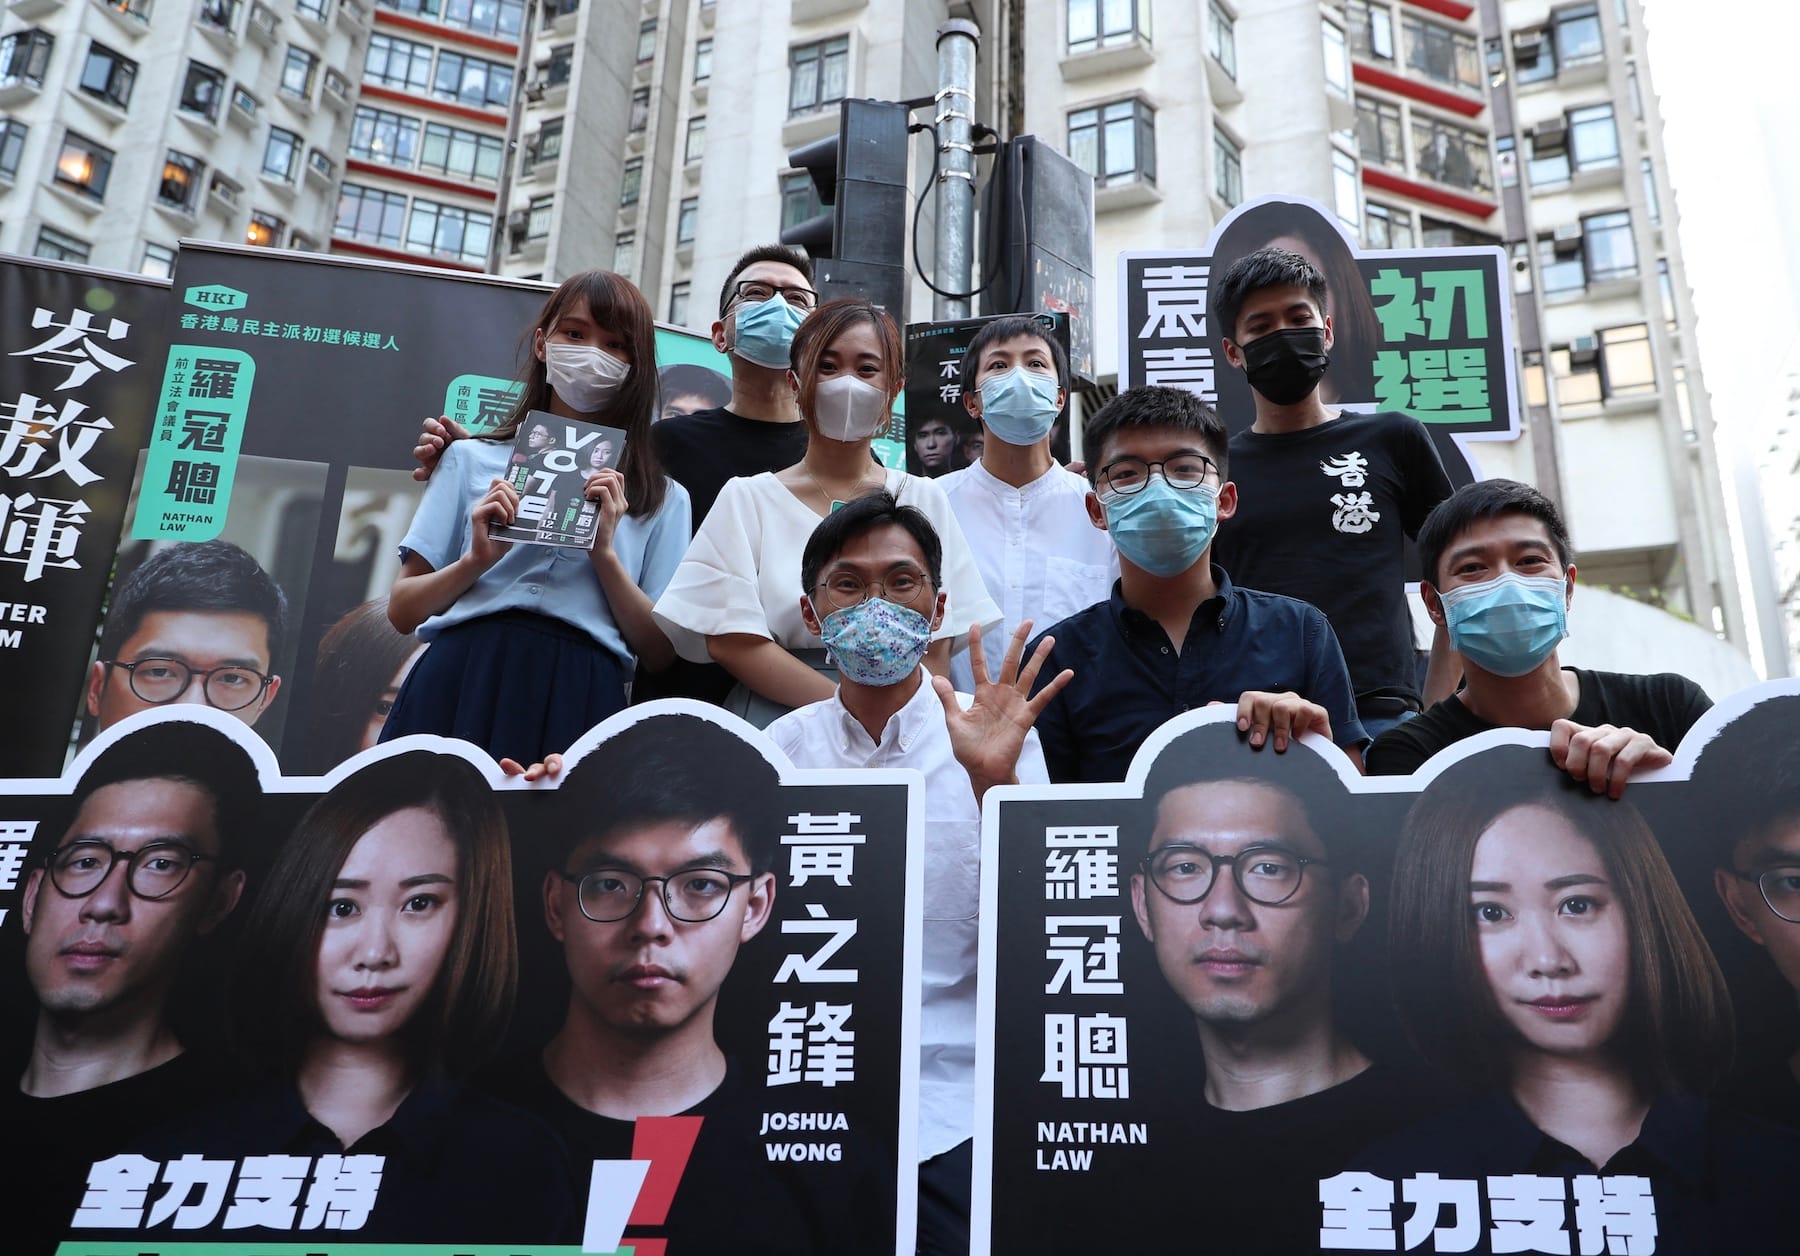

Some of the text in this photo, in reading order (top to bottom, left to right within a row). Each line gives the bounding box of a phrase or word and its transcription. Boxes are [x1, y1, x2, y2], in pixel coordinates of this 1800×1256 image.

[195, 291, 236, 305] HKI
[180, 313, 400, 351] 香港島民主派初選候選人
[1370, 269, 1492, 424] 初選
[160, 357, 189, 442] 前立法會議員
[455, 386, 471, 424] 南區區
[163, 358, 241, 505] 羅冠聰
[1320, 451, 1380, 534] 香港
[159, 523, 186, 532] LAW
[162, 512, 213, 524] NATHAN
[766, 812, 866, 1087] 黃之鋒
[1039, 826, 1129, 1099] 羅冠聰
[760, 1112, 849, 1136] JOSHUA
[1037, 1121, 1148, 1145] NATHAN
[765, 1143, 842, 1162] WONG
[1036, 1149, 1093, 1171] LAW
[70, 1153, 386, 1231] 全力支持
[1319, 1171, 1658, 1256] 全力支持
